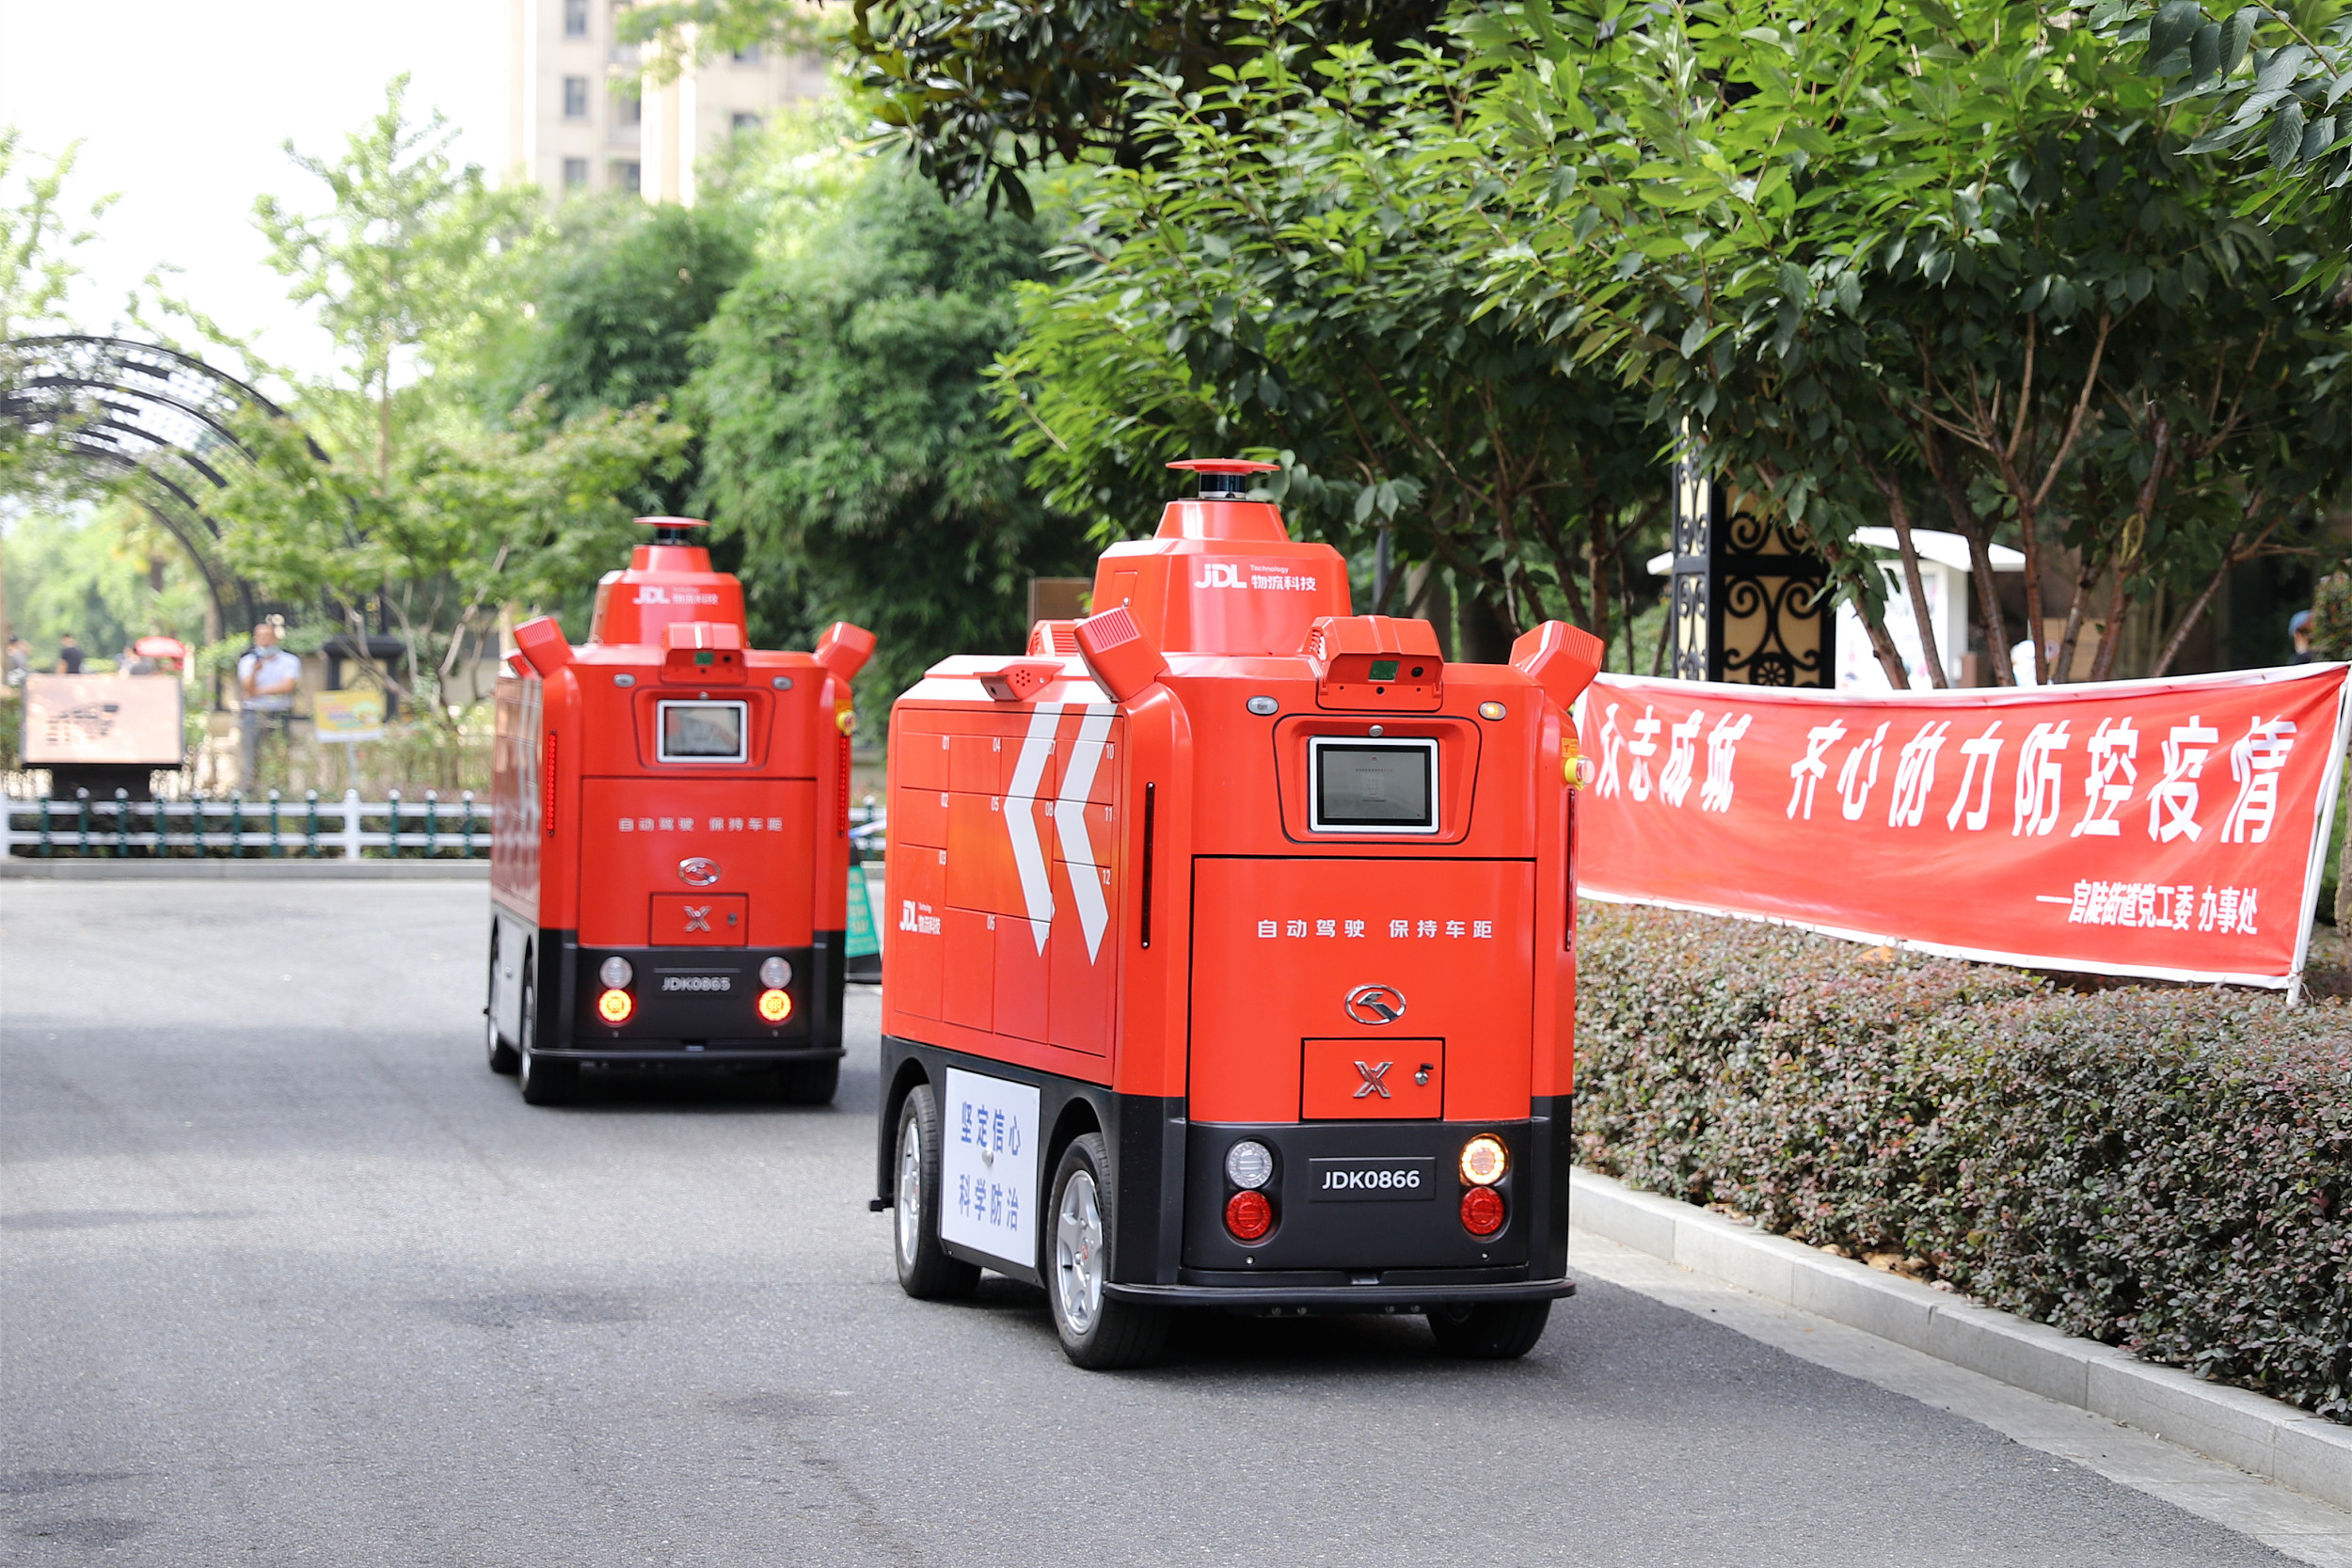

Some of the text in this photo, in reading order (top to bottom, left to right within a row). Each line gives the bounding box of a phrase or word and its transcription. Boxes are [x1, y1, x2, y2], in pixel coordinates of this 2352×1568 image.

[1194, 563, 1248, 589] JDL
[1250, 564, 1289, 574] Technology
[1251, 575, 1316, 592] 物流科技
[633, 586, 670, 605] JDL
[993, 737, 1001, 752] 04
[1106, 744, 1115, 760] 10
[1596, 703, 2297, 844] 众志成城 齐心协力防控疫情
[1104, 806, 1113, 822] 11
[618, 817, 783, 832] 自动驾驶 保持车距
[1103, 869, 1111, 885] 12
[899, 899, 918, 932] JDL
[2198, 885, 2258, 935] 办事处
[1258, 919, 1493, 939] 自动驾驶 保持车距
[661, 976, 731, 991] JDK0865
[961, 1101, 1021, 1156] 坚定信心
[1322, 1170, 1421, 1190] JDK0866
[959, 1174, 1019, 1232] 科学防治
